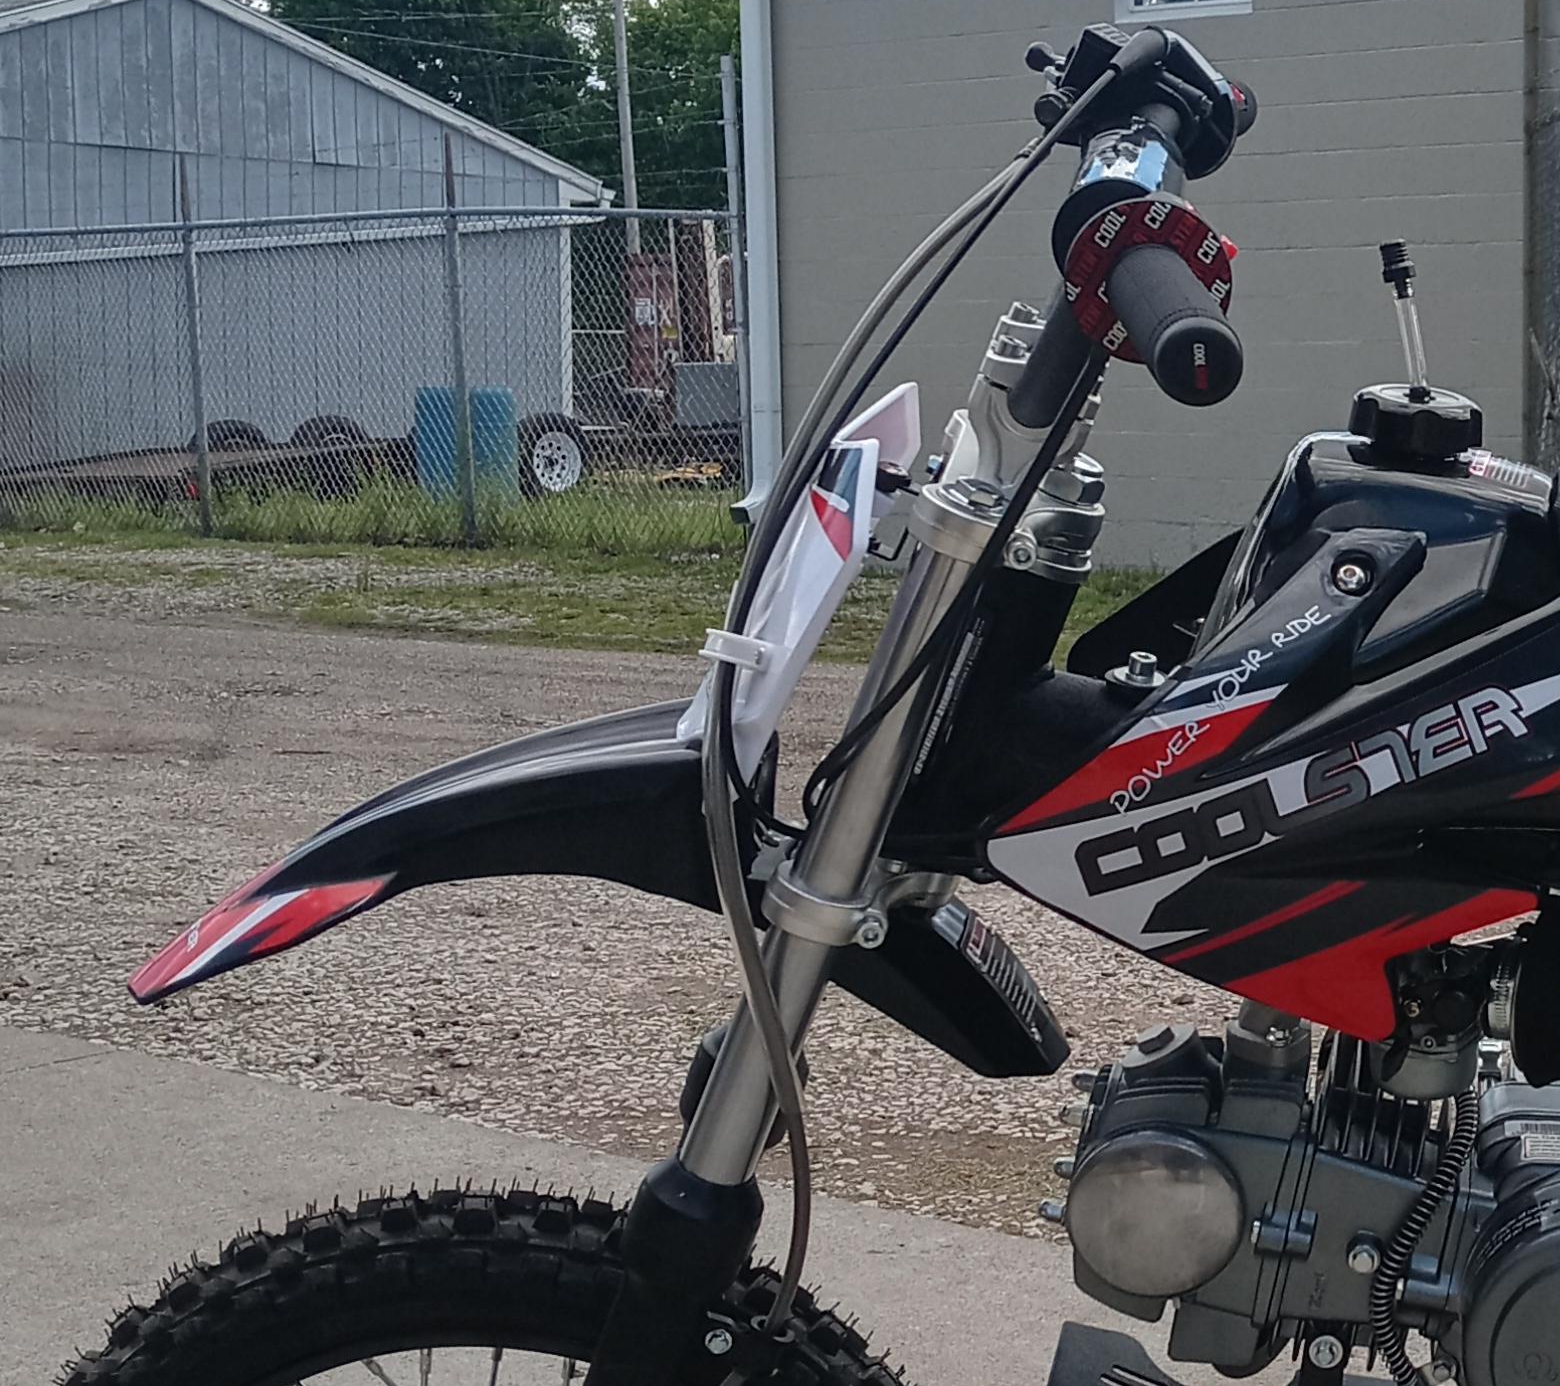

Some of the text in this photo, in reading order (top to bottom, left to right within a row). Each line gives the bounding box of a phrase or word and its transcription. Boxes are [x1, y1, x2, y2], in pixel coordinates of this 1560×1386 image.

[1094, 211, 1127, 248] COOL
[1197, 232, 1221, 265] CO
[1102, 320, 1129, 351] COO
[1193, 343, 1206, 366] COOL
[1109, 605, 1332, 815] POWER YOUR RIDE
[1075, 685, 1529, 897] COOLSTER
